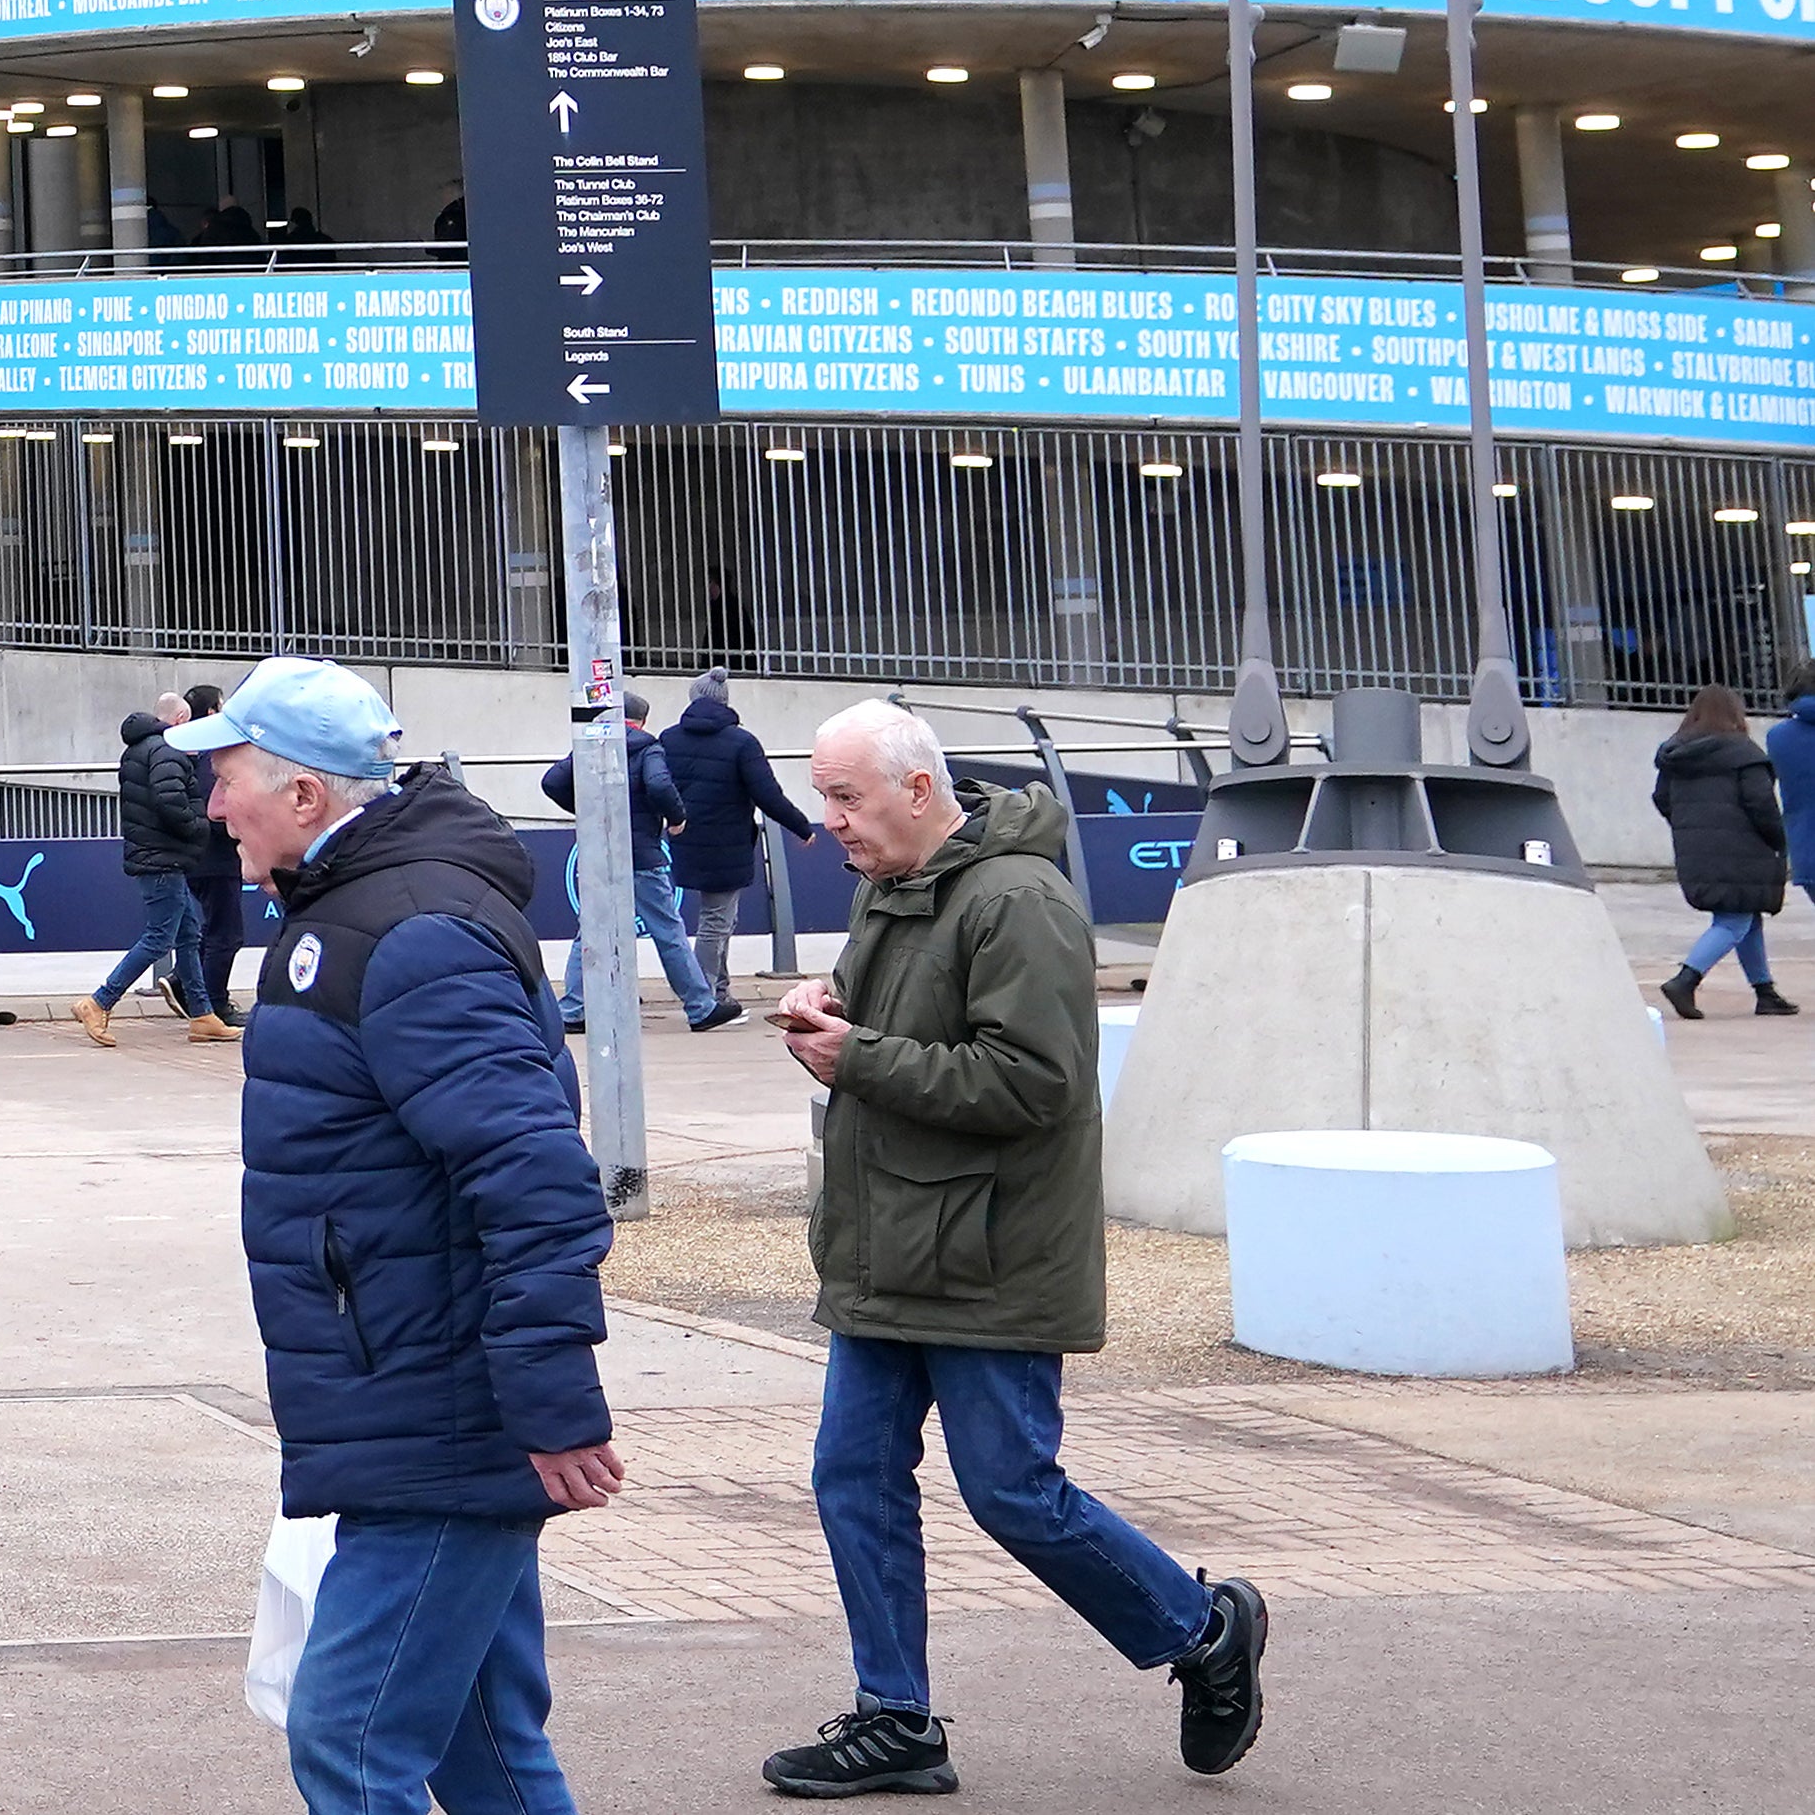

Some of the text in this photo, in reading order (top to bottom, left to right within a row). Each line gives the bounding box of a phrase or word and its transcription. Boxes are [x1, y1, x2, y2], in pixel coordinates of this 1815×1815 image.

[545, 7, 588, 17] Platinum
[591, 6, 622, 17] Boxes
[651, 6, 664, 16] 73
[545, 22, 585, 32] Citizens
[546, 37, 598, 48] Joe's East
[548, 52, 618, 63] 1894 Club Bar
[548, 66, 669, 78] The Commonwealth Bar
[553, 155, 658, 167] The Colin Bell Stand
[555, 179, 635, 190] The Tunnel Club
[556, 195, 599, 205] Platinum
[602, 195, 633, 205] Boxes
[557, 211, 576, 221] The
[636, 210, 660, 220] Club
[557, 226, 634, 237] The Mancunian
[559, 242, 613, 253] Joe's West
[93, 290, 1793, 349] PUNE RALEIGH BEACH CITY MOSS SABAH
[564, 327, 628, 338] South Stand
[77, 325, 1792, 386] SINGAPORE FLORIDA CITYZENS STAFFS WEST STALYBRIDGE
[565, 351, 609, 364] Legends
[60, 363, 1705, 417] TLEMCEN TOKYO TORONTO TUNIS ULAANBAATAR WARWICK
